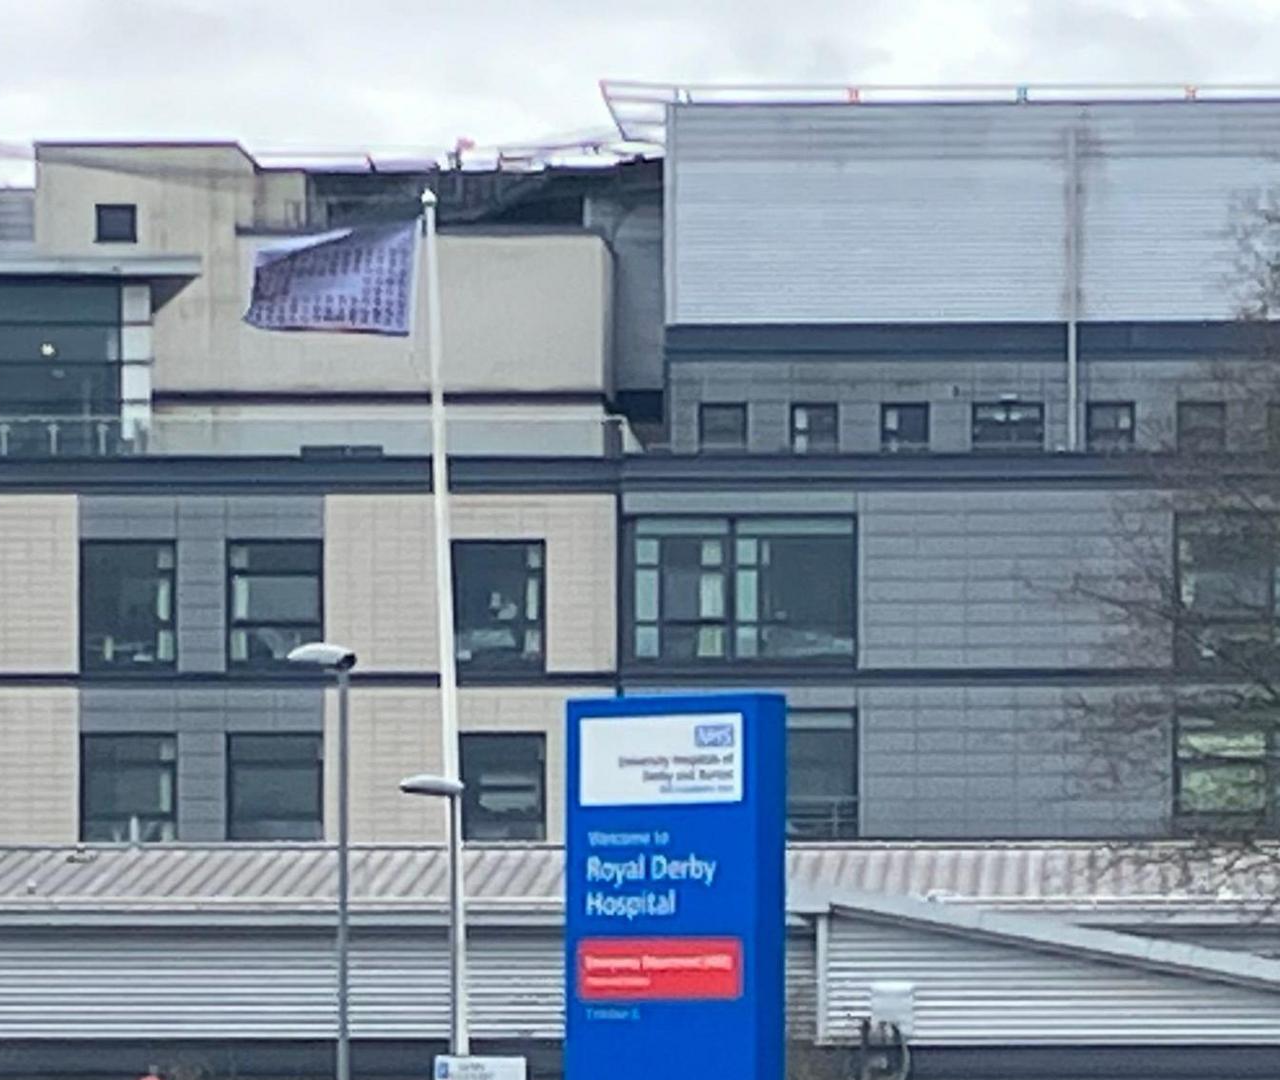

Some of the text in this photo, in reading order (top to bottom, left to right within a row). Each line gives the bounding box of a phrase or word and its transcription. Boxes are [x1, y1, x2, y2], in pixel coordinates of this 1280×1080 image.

[696, 725, 733, 746] NHS
[588, 831, 669, 846] Welcome to
[587, 853, 717, 888] Royal Derby
[586, 889, 676, 921] Hospital
